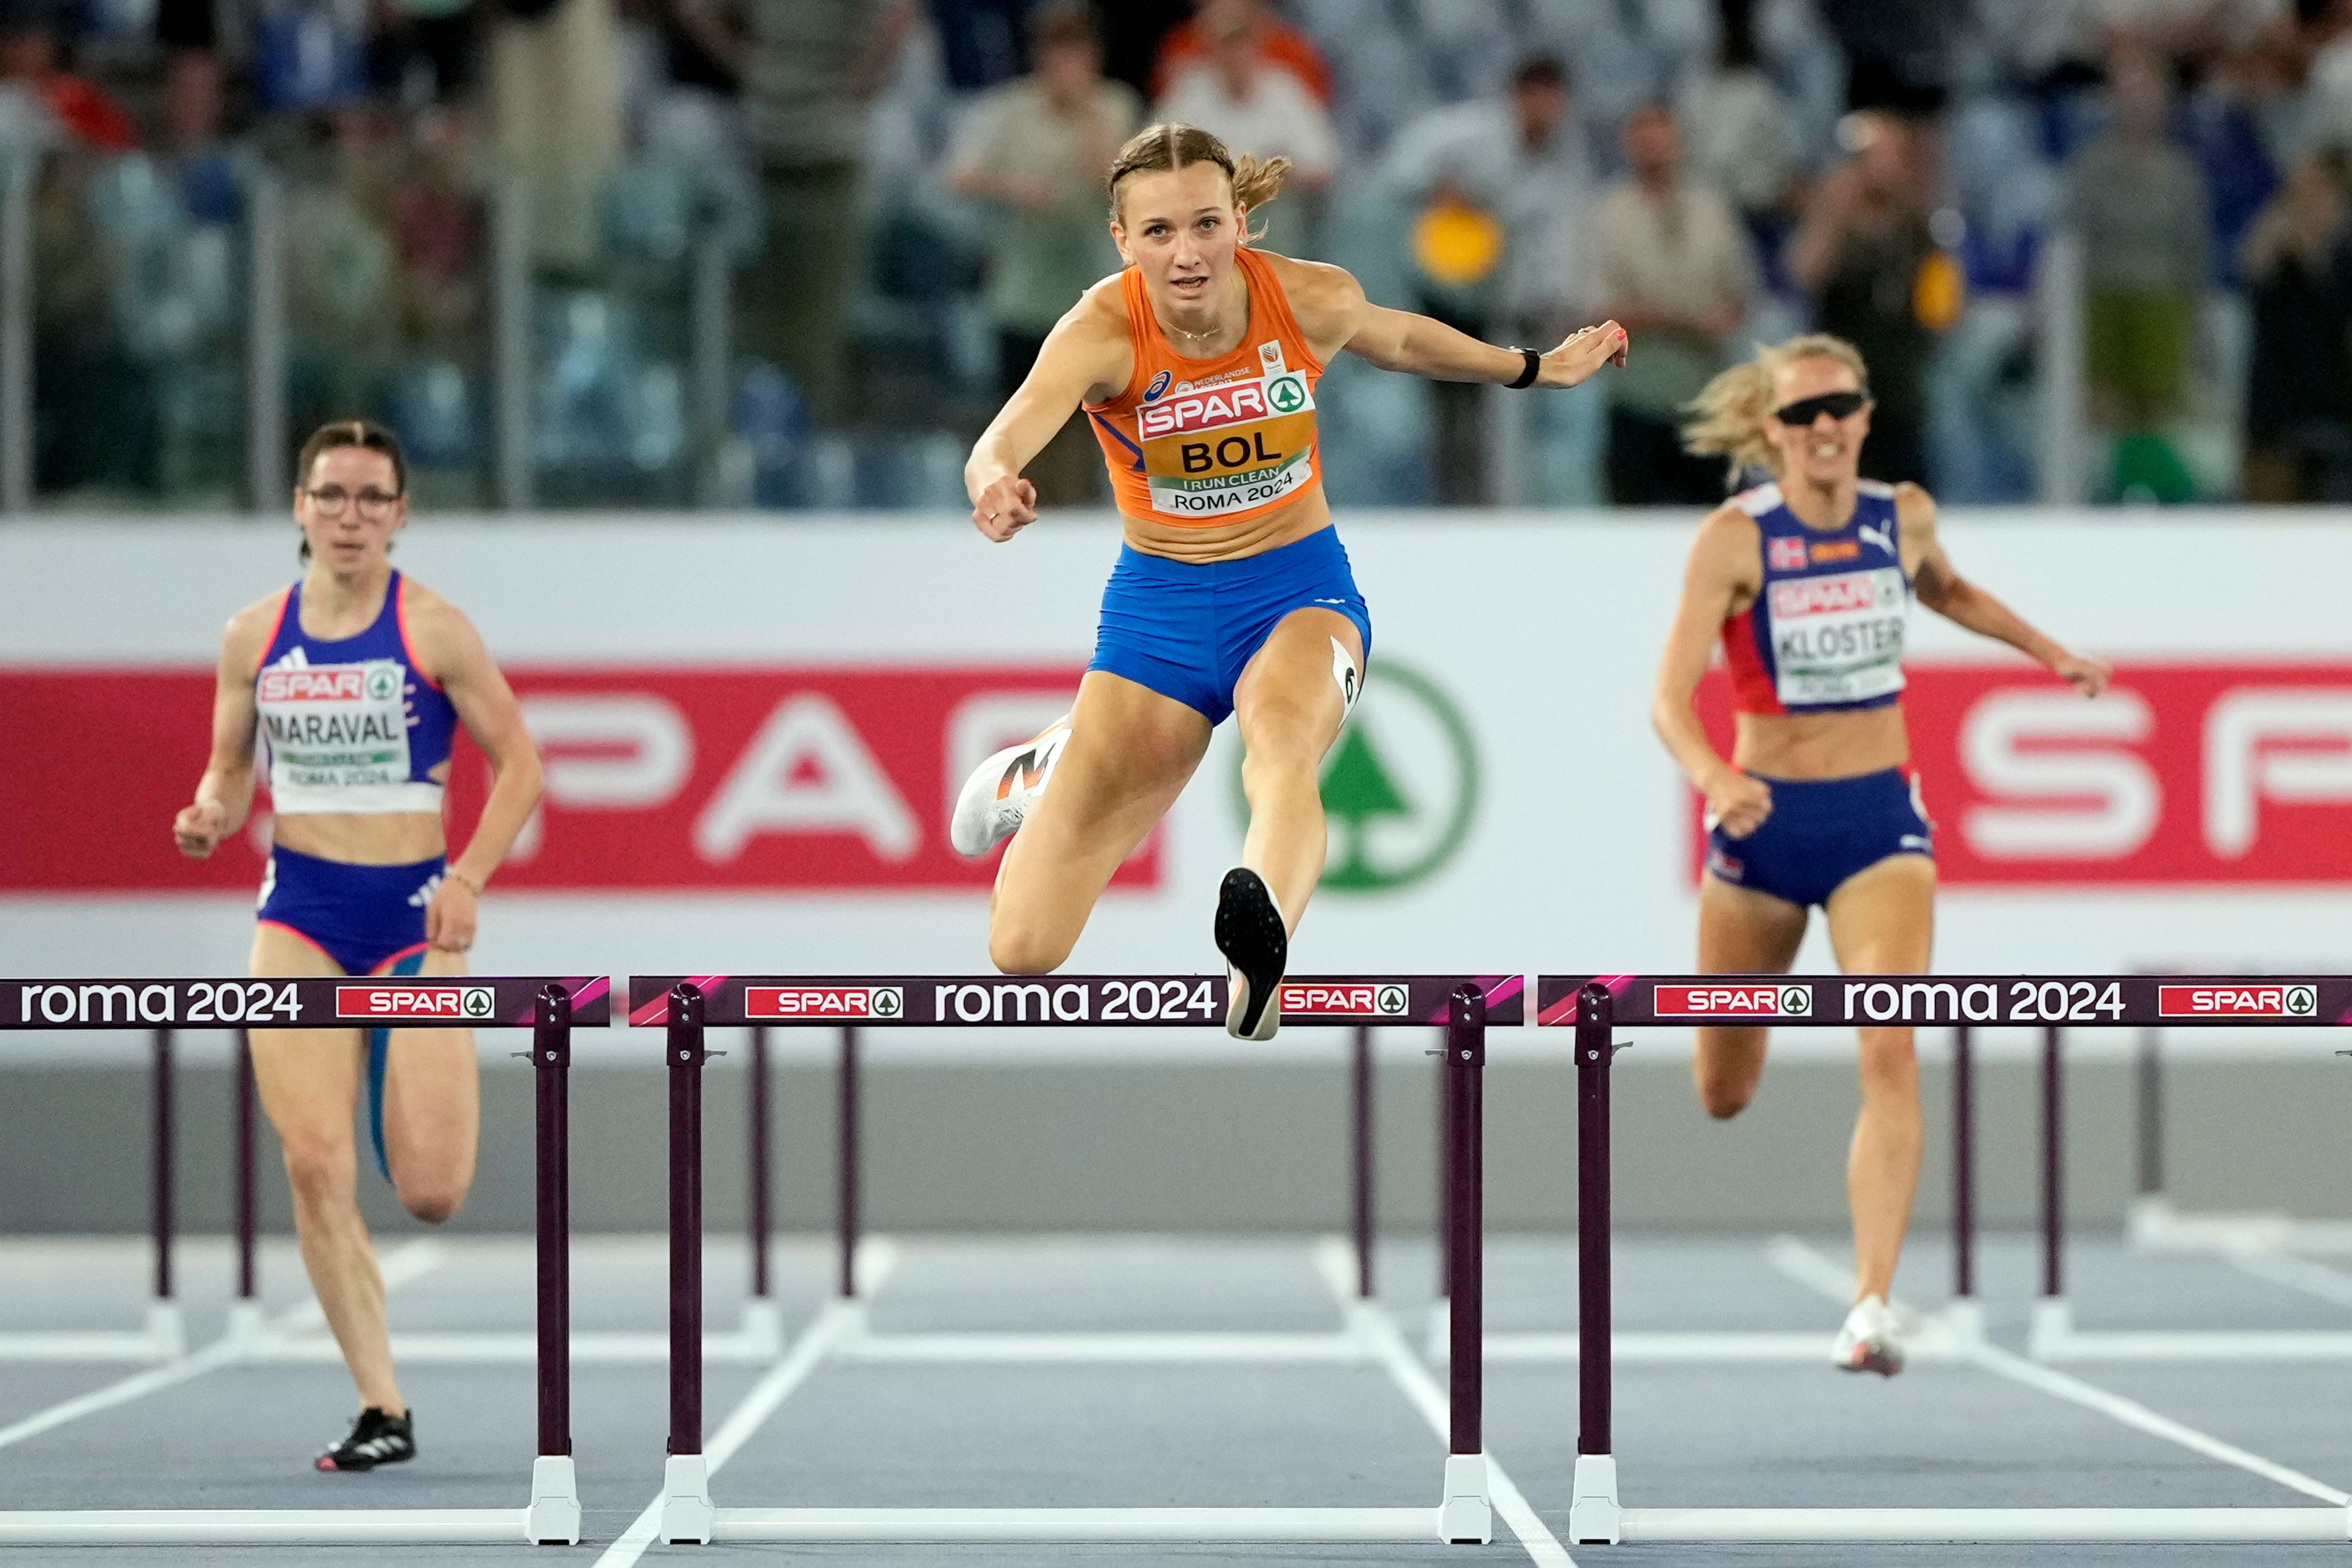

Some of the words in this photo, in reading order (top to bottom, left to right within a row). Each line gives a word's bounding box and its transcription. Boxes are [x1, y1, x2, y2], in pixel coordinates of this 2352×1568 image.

[1194, 366, 1251, 386] NEDERLANDSE
[1145, 386, 1264, 432] SPAR
[1181, 432, 1282, 473] BOL
[1175, 492, 1242, 511] ROMA
[1248, 472, 1294, 502] 2024
[1191, 477, 1226, 491] RUN
[1229, 467, 1280, 485] CLEAN
[263, 673, 362, 699] SPAR
[265, 713, 398, 745] MARAVAL
[21, 984, 175, 1023] roma
[187, 982, 303, 1021] 2024
[369, 992, 459, 1012] SPAR
[778, 992, 869, 1012] SPAR
[935, 984, 1089, 1022] roma
[1101, 981, 1218, 1020] 2024
[1284, 989, 1373, 1009] SPAR
[1687, 990, 1776, 1011] SPAR
[1844, 983, 1998, 1021] roma
[2010, 981, 2126, 1020] 2024
[2192, 990, 2281, 1011] SPAR
